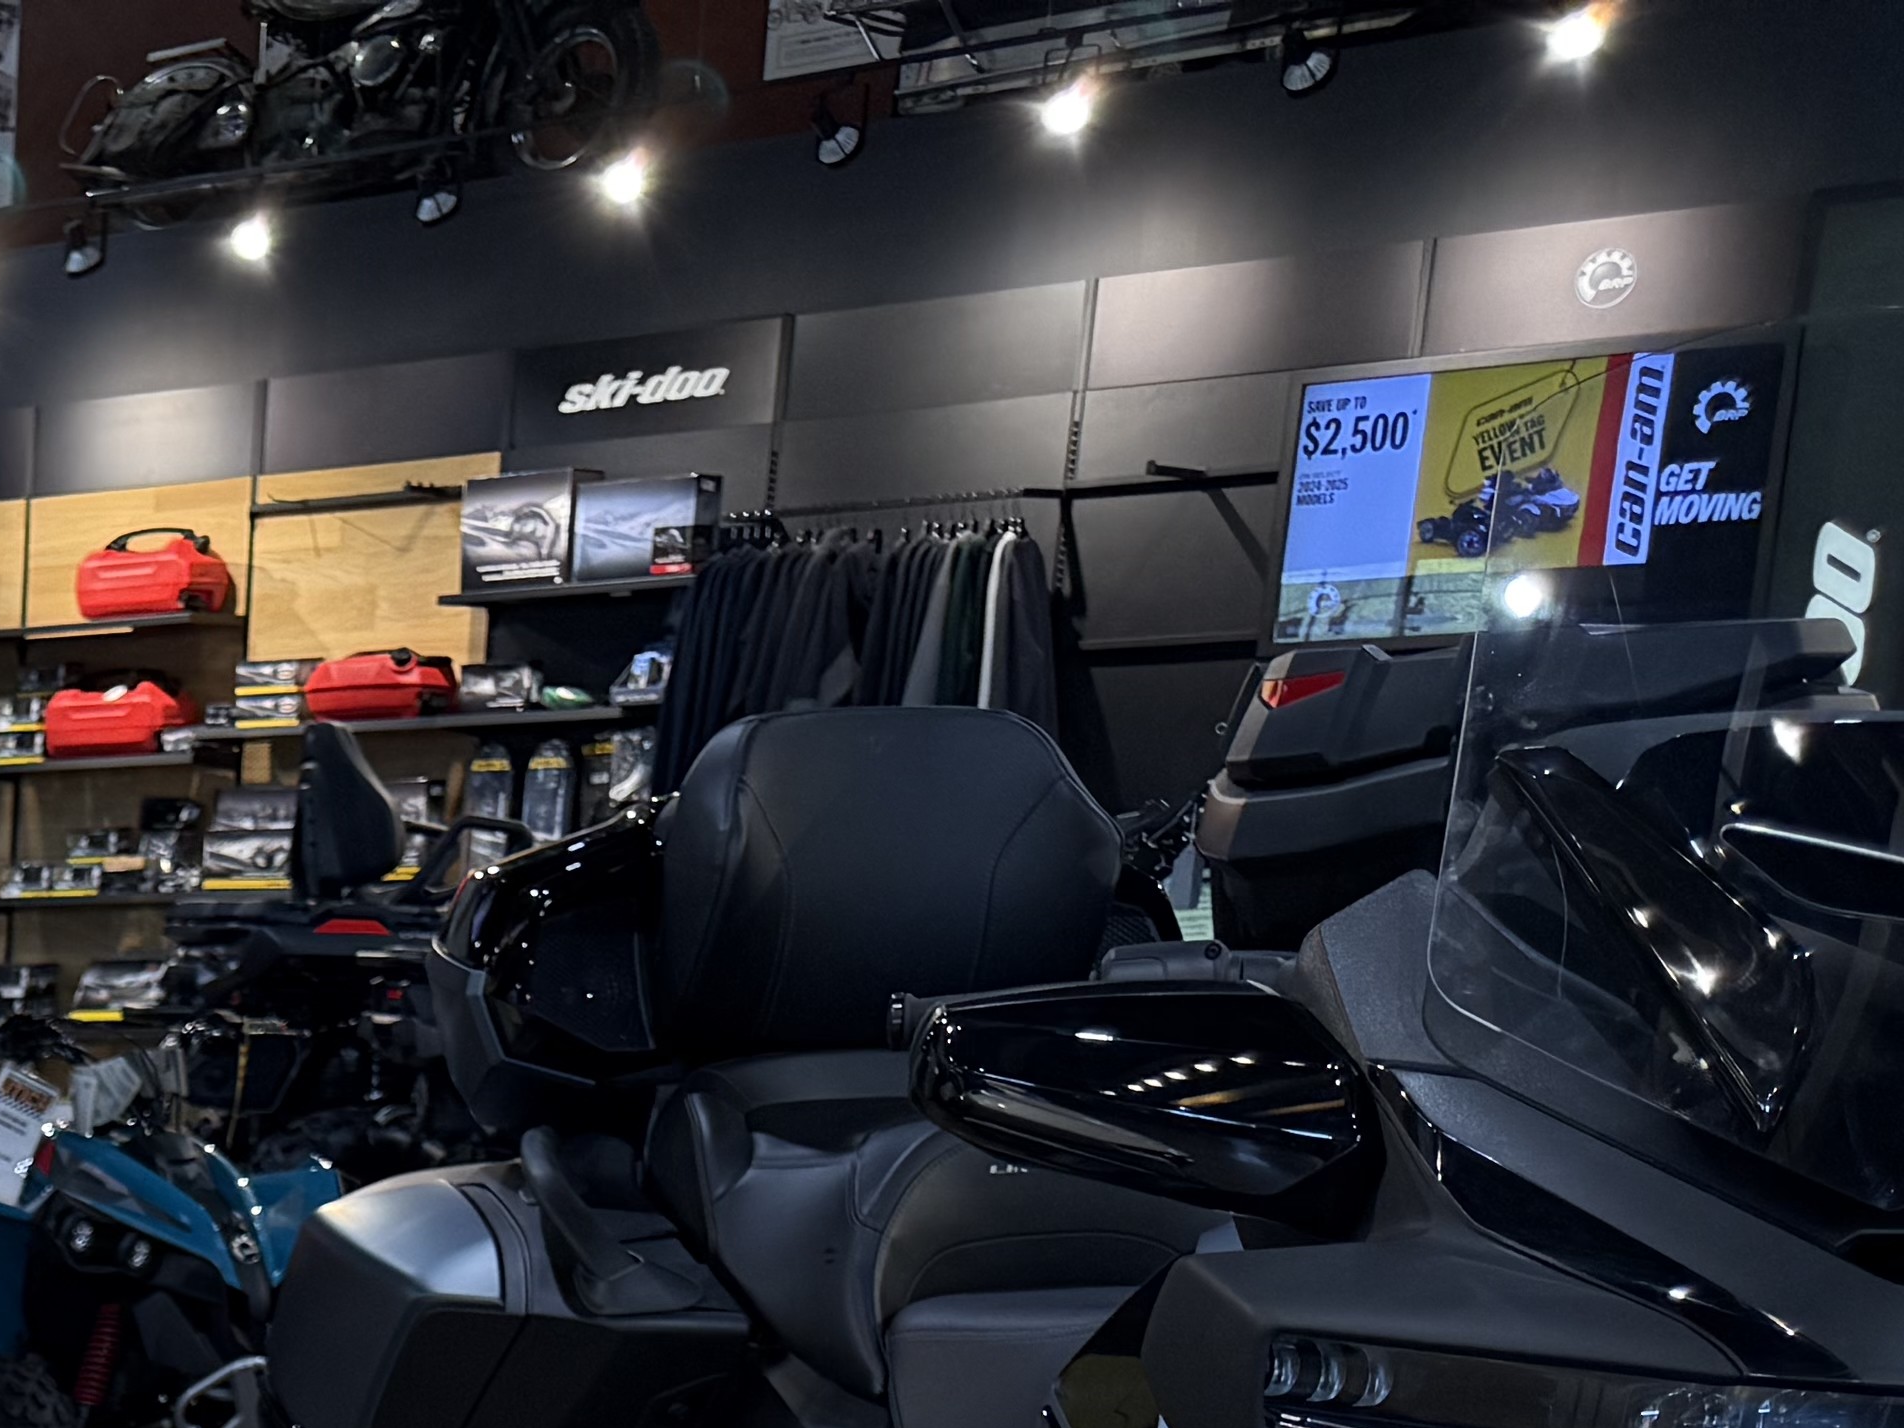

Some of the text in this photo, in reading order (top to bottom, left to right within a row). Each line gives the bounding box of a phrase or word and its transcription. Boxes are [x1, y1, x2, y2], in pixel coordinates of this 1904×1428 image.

[558, 366, 730, 414] ski-doo
[1307, 396, 1367, 414] SAVE UP TO
[1473, 414, 1546, 446] YELLOW TAG
[1477, 427, 1546, 472] EVENT
[1615, 365, 1665, 557] can-am
[1659, 460, 1721, 492] GET
[1654, 491, 1762, 526] MOVING
